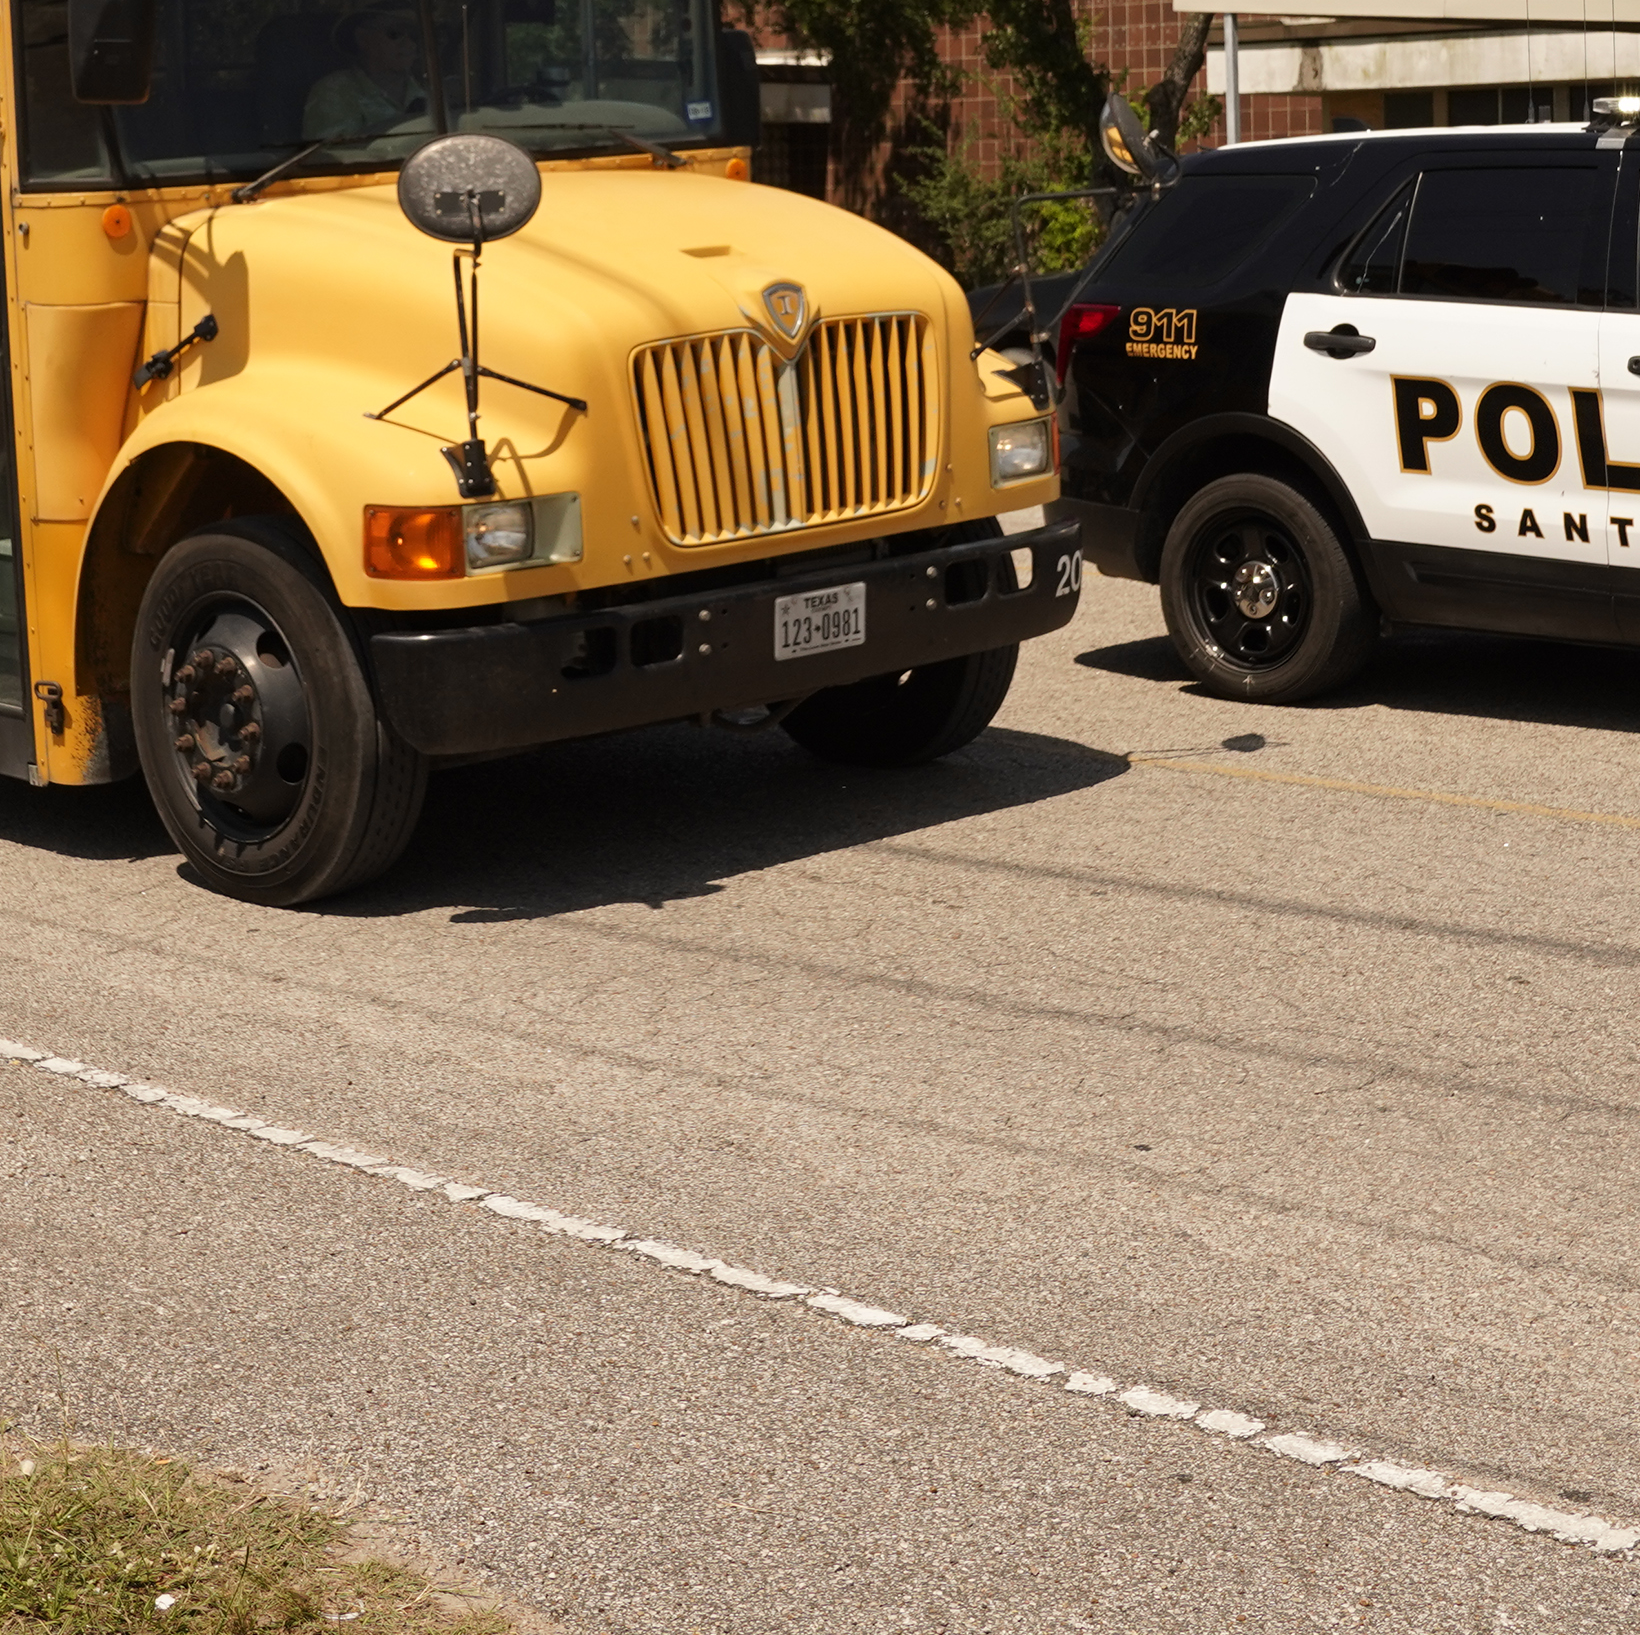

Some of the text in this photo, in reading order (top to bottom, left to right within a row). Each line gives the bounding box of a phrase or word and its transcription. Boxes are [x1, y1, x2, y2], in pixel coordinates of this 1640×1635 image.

[1129, 307, 1197, 343] 911
[1125, 342, 1199, 360] EMERGENCY
[803, 592, 839, 609] TEXAS
